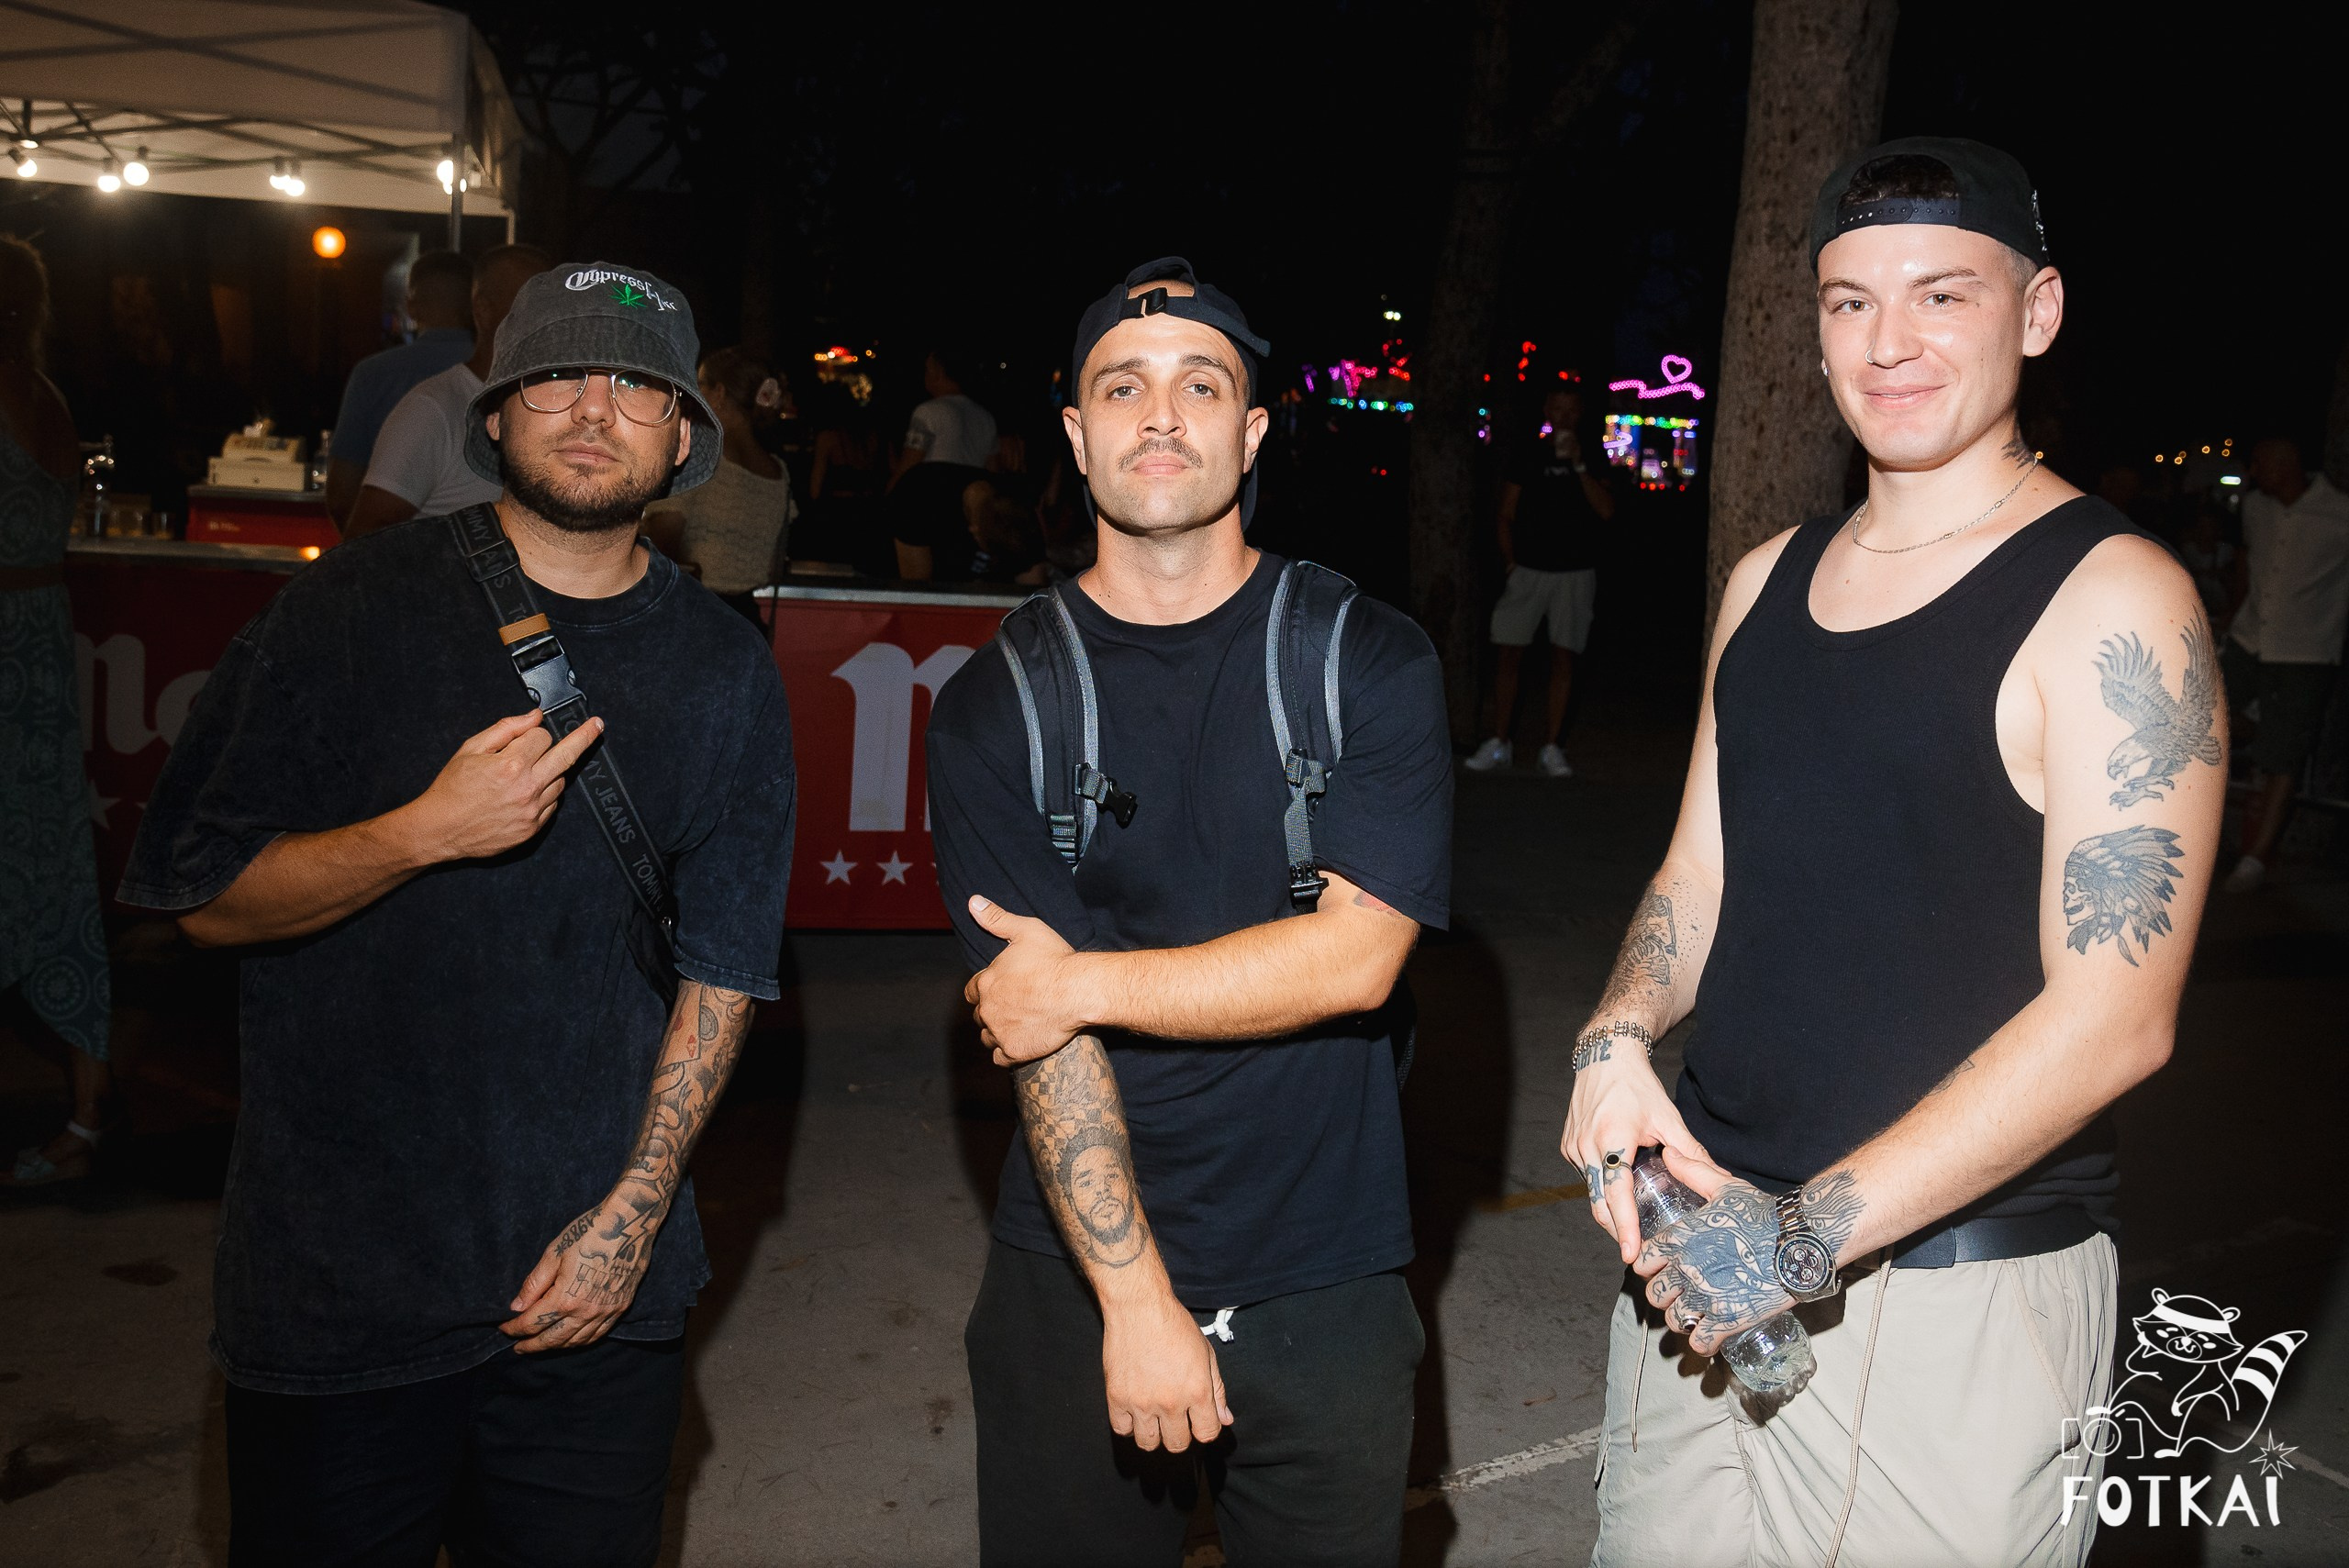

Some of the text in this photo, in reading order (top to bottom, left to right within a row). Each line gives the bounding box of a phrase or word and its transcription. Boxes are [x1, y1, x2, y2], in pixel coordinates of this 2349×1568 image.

[564, 269, 645, 291] Cypress
[595, 786, 637, 844] JEANS
[631, 853, 663, 905] TOMMY
